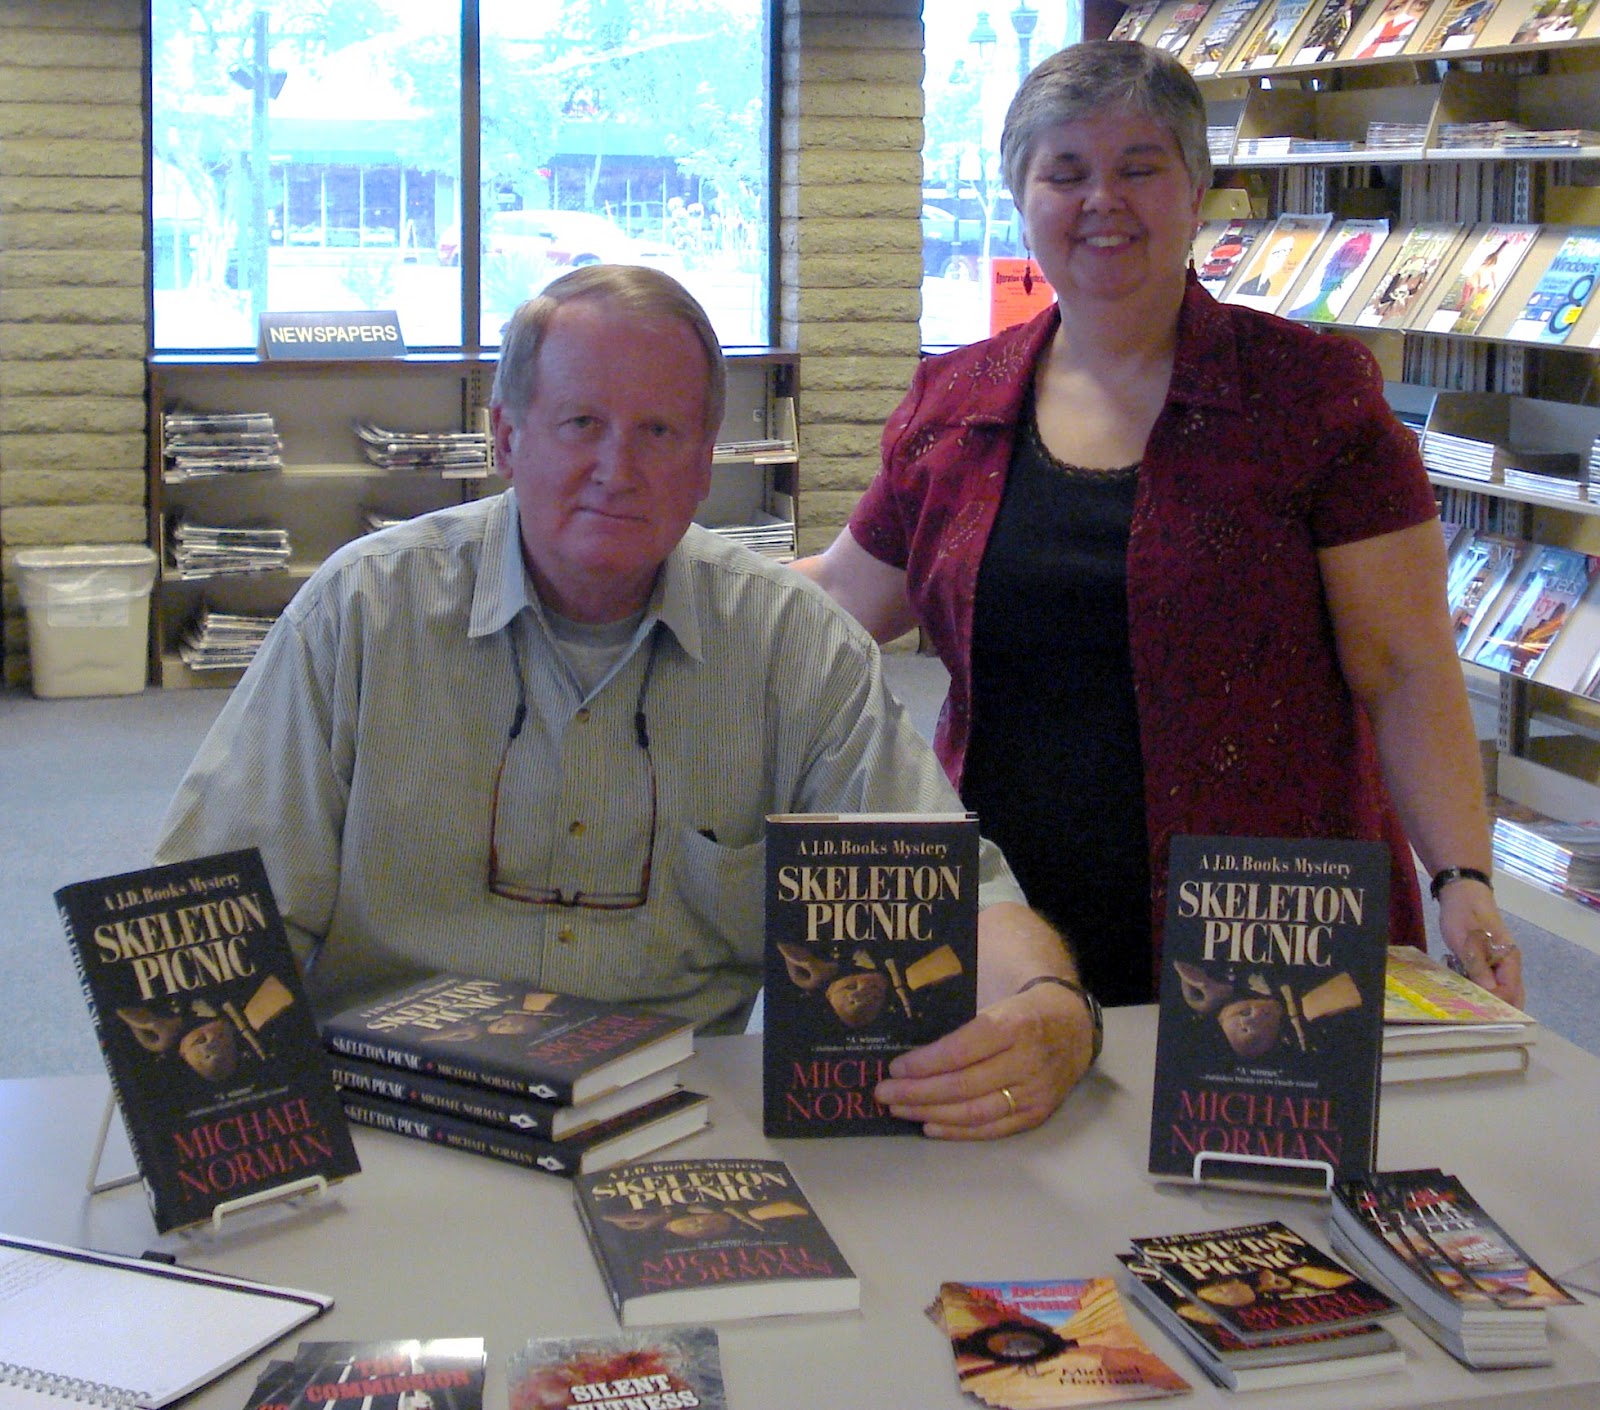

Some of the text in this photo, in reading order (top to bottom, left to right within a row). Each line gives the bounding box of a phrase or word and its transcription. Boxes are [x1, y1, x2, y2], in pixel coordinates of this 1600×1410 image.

[1550, 257, 1599, 273] Windows
[270, 325, 398, 343] NEWSPAPERS
[797, 840, 947, 859] A J.D. Books Mystery
[1199, 854, 1351, 880] A J.D. Books Mystery
[142, 882, 188, 903] Books
[187, 874, 239, 896] Mystery
[777, 865, 961, 901] SKELETON
[1177, 880, 1366, 926] SKELETON
[94, 893, 268, 964] SKELETON
[805, 902, 933, 942] PICNIC
[1201, 921, 1333, 967] PICNIC
[133, 935, 256, 1000] PICNIC
[366, 980, 500, 1033] SKELETON
[332, 1037, 526, 1092] SKELETON PICNIC MICHAEL NORMAN
[792, 1059, 884, 1088] MICH
[371, 1077, 405, 1099] PICNIC
[420, 1093, 461, 1111] MICHAEL
[462, 1103, 507, 1122] NORMAN
[1179, 1090, 1338, 1131] MICHAEL
[172, 1098, 320, 1164] MICHAEL
[344, 1104, 394, 1130] SKELETON
[396, 1117, 431, 1139] PICNIC
[1171, 1123, 1343, 1167] NORMAN
[177, 1130, 333, 1201] NORMAN
[591, 1171, 789, 1201] SKELETON
[627, 1184, 768, 1210] PICNIC
[1143, 1230, 1305, 1264] SKELETON
[1181, 1250, 1308, 1280] PICNIC
[305, 1369, 470, 1402] COMMISSION
[571, 1373, 671, 1402] SILENT
